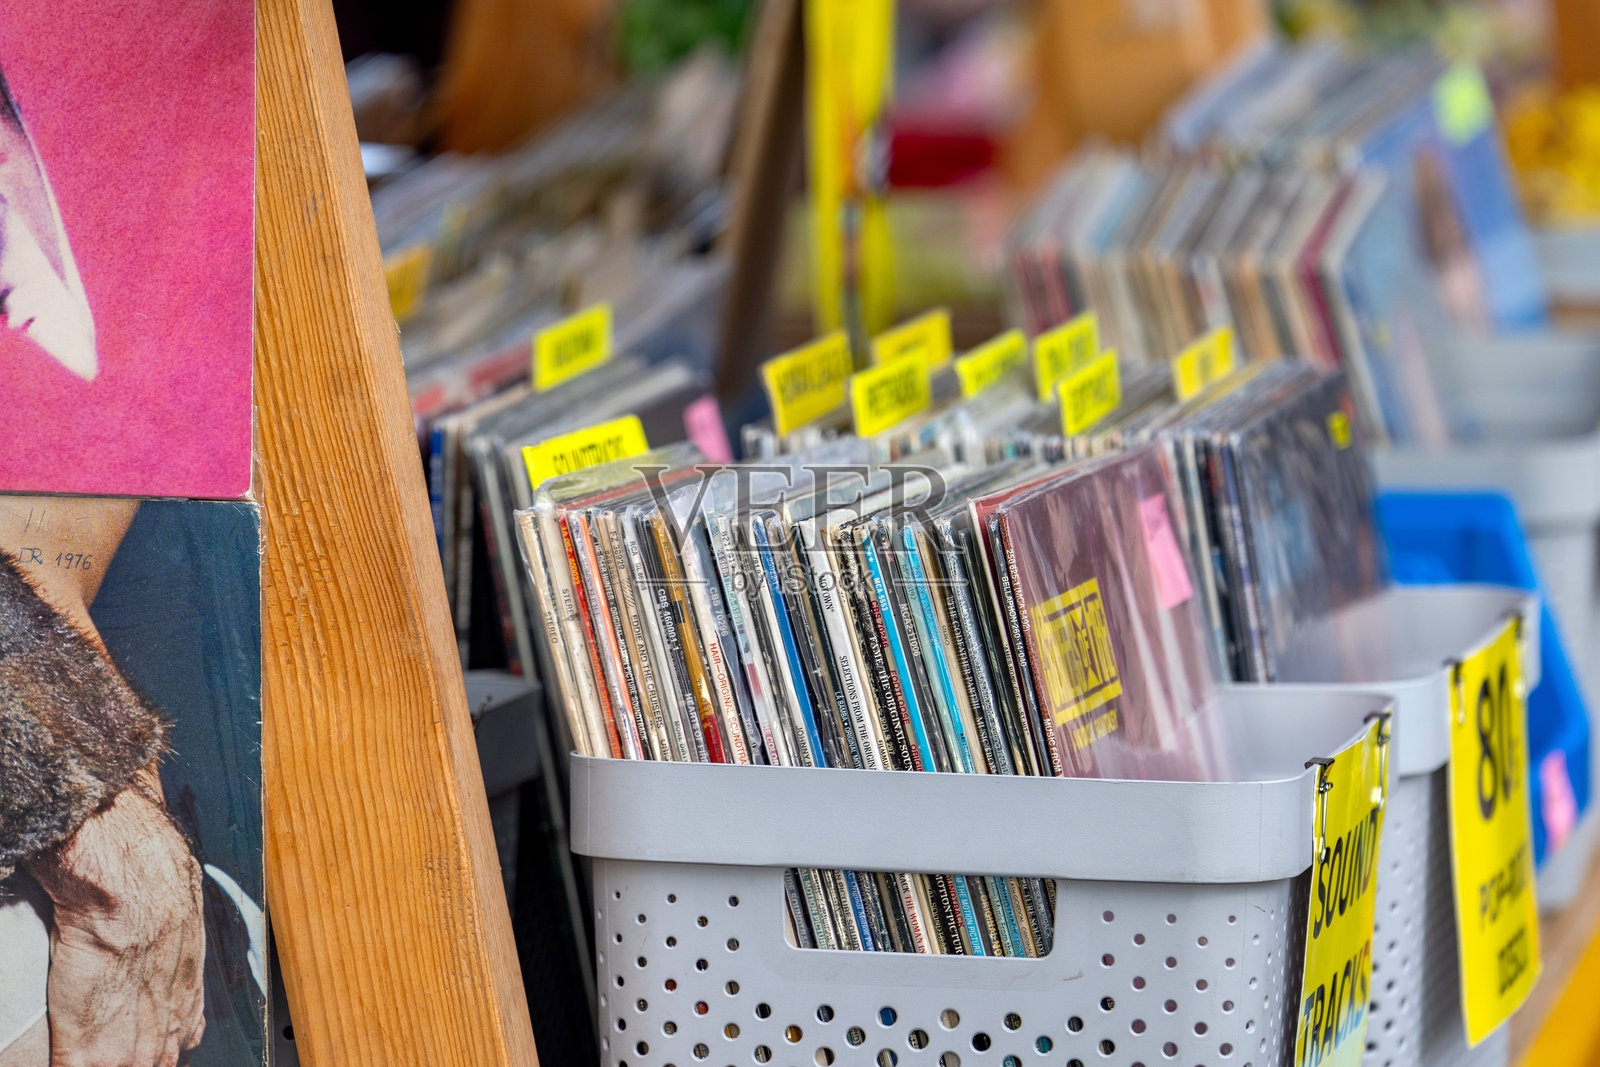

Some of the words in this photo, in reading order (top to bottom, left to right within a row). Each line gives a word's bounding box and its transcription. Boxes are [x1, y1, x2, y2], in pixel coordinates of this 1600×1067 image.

[609, 530, 617, 542] FZ
[629, 540, 638, 556] RCA
[55, 552, 94, 580] 1976
[708, 586, 720, 607] CBS
[714, 608, 728, 637] 70296
[1000, 575, 1017, 623] BELLAPHON
[1013, 586, 1025, 609] (MCA
[543, 611, 558, 644] STEREO
[629, 614, 643, 642] EDDIE
[899, 602, 920, 656] MCA2-11006
[601, 572, 614, 600] HUNTER
[609, 606, 623, 636] ORIGINAL
[623, 665, 636, 694] PICTURE
[631, 696, 647, 741] SOUNDTRACK
[637, 642, 648, 662] AND
[657, 587, 668, 608] CBS
[684, 692, 700, 729] HEARTS
[694, 730, 703, 743] OF
[870, 599, 881, 619] CBS
[876, 620, 889, 648] 70246
[889, 669, 910, 724] FOOTLOOSE
[1002, 643, 1012, 664] AMES
[642, 663, 653, 682] THE
[951, 620, 971, 675] GODFATHER
[965, 675, 977, 698] PART
[975, 715, 989, 745] MUSIC
[646, 682, 664, 728] CRUISERS
[839, 654, 857, 700] SELECTIONS
[851, 700, 863, 723] FROM
[857, 723, 868, 740] THE
[837, 700, 848, 721] BAMBA
[843, 726, 856, 753] ORIGINAL
[883, 691, 904, 743] ORIGINAL
[1043, 717, 1056, 746] MUSIC
[765, 736, 779, 766] COLOR
[796, 726, 810, 759] JOHNNY
[1049, 746, 1062, 772] FROM
[1313, 807, 1380, 940] SOUND
[803, 879, 817, 913] MOTION
[837, 881, 851, 918] PICTURE
[849, 880, 862, 909] Original
[857, 910, 869, 935] Motion
[904, 895, 915, 912] THE
[957, 884, 965, 898] THE
[908, 912, 923, 943] WOMAN
[960, 898, 973, 924] MOTION
[979, 894, 997, 937] ORIGINAL
[1013, 894, 1024, 922] GORDON
[1020, 926, 1032, 954] ORIGINAL
[967, 925, 980, 954] PICTURE
[1302, 940, 1371, 1067] TRACKS
